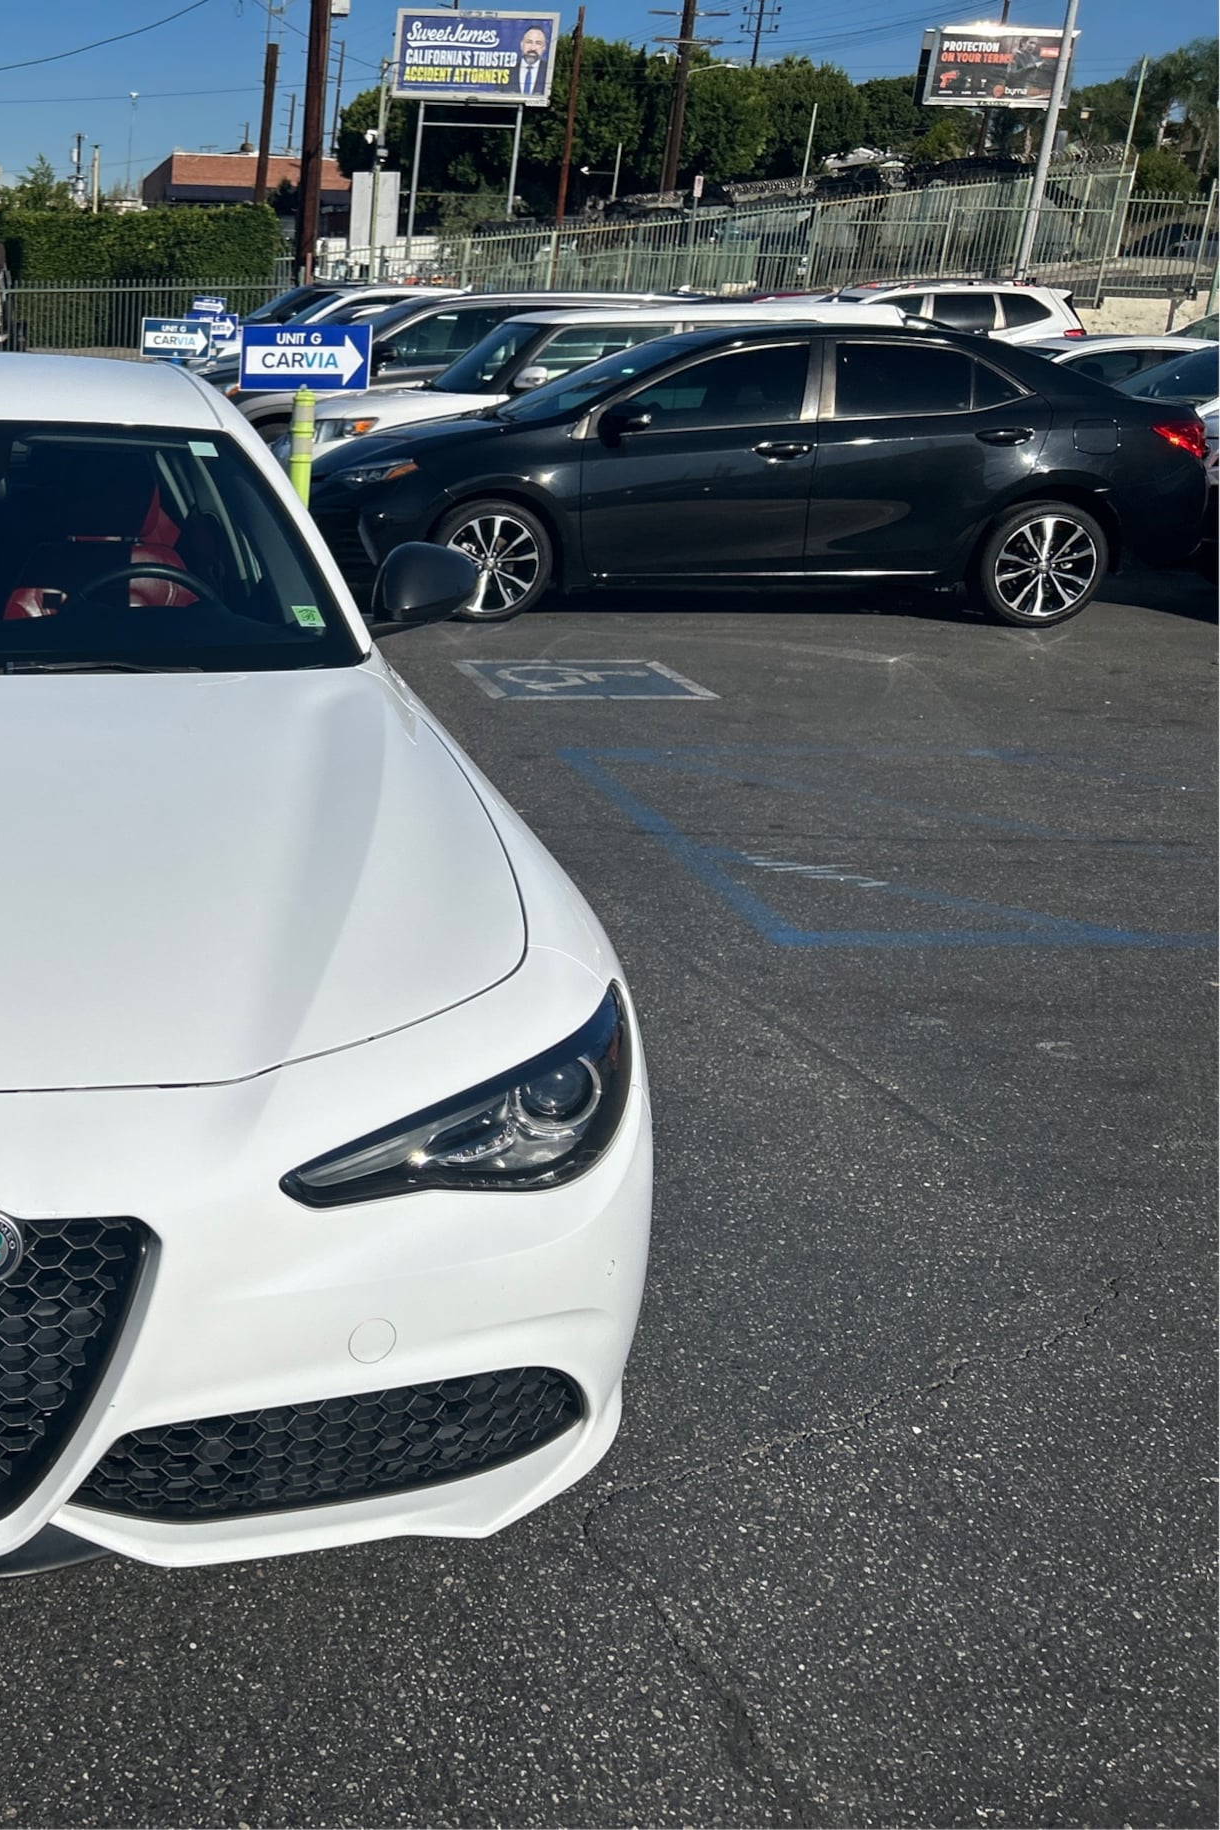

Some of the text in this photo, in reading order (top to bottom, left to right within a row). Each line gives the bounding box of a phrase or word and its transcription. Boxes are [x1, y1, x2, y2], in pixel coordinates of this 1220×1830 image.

[943, 41, 1000, 53] PROTECTION
[405, 49, 518, 67] CALIFORNIA'S TRUSTED
[941, 52, 956, 62] ON
[957, 52, 981, 63] YOUR
[403, 66, 510, 84] ACCIDENT ATTORNEYS
[153, 335, 196, 346] CARVIA
[276, 332, 322, 344] UNIT G
[262, 352, 338, 369] CARVIA
